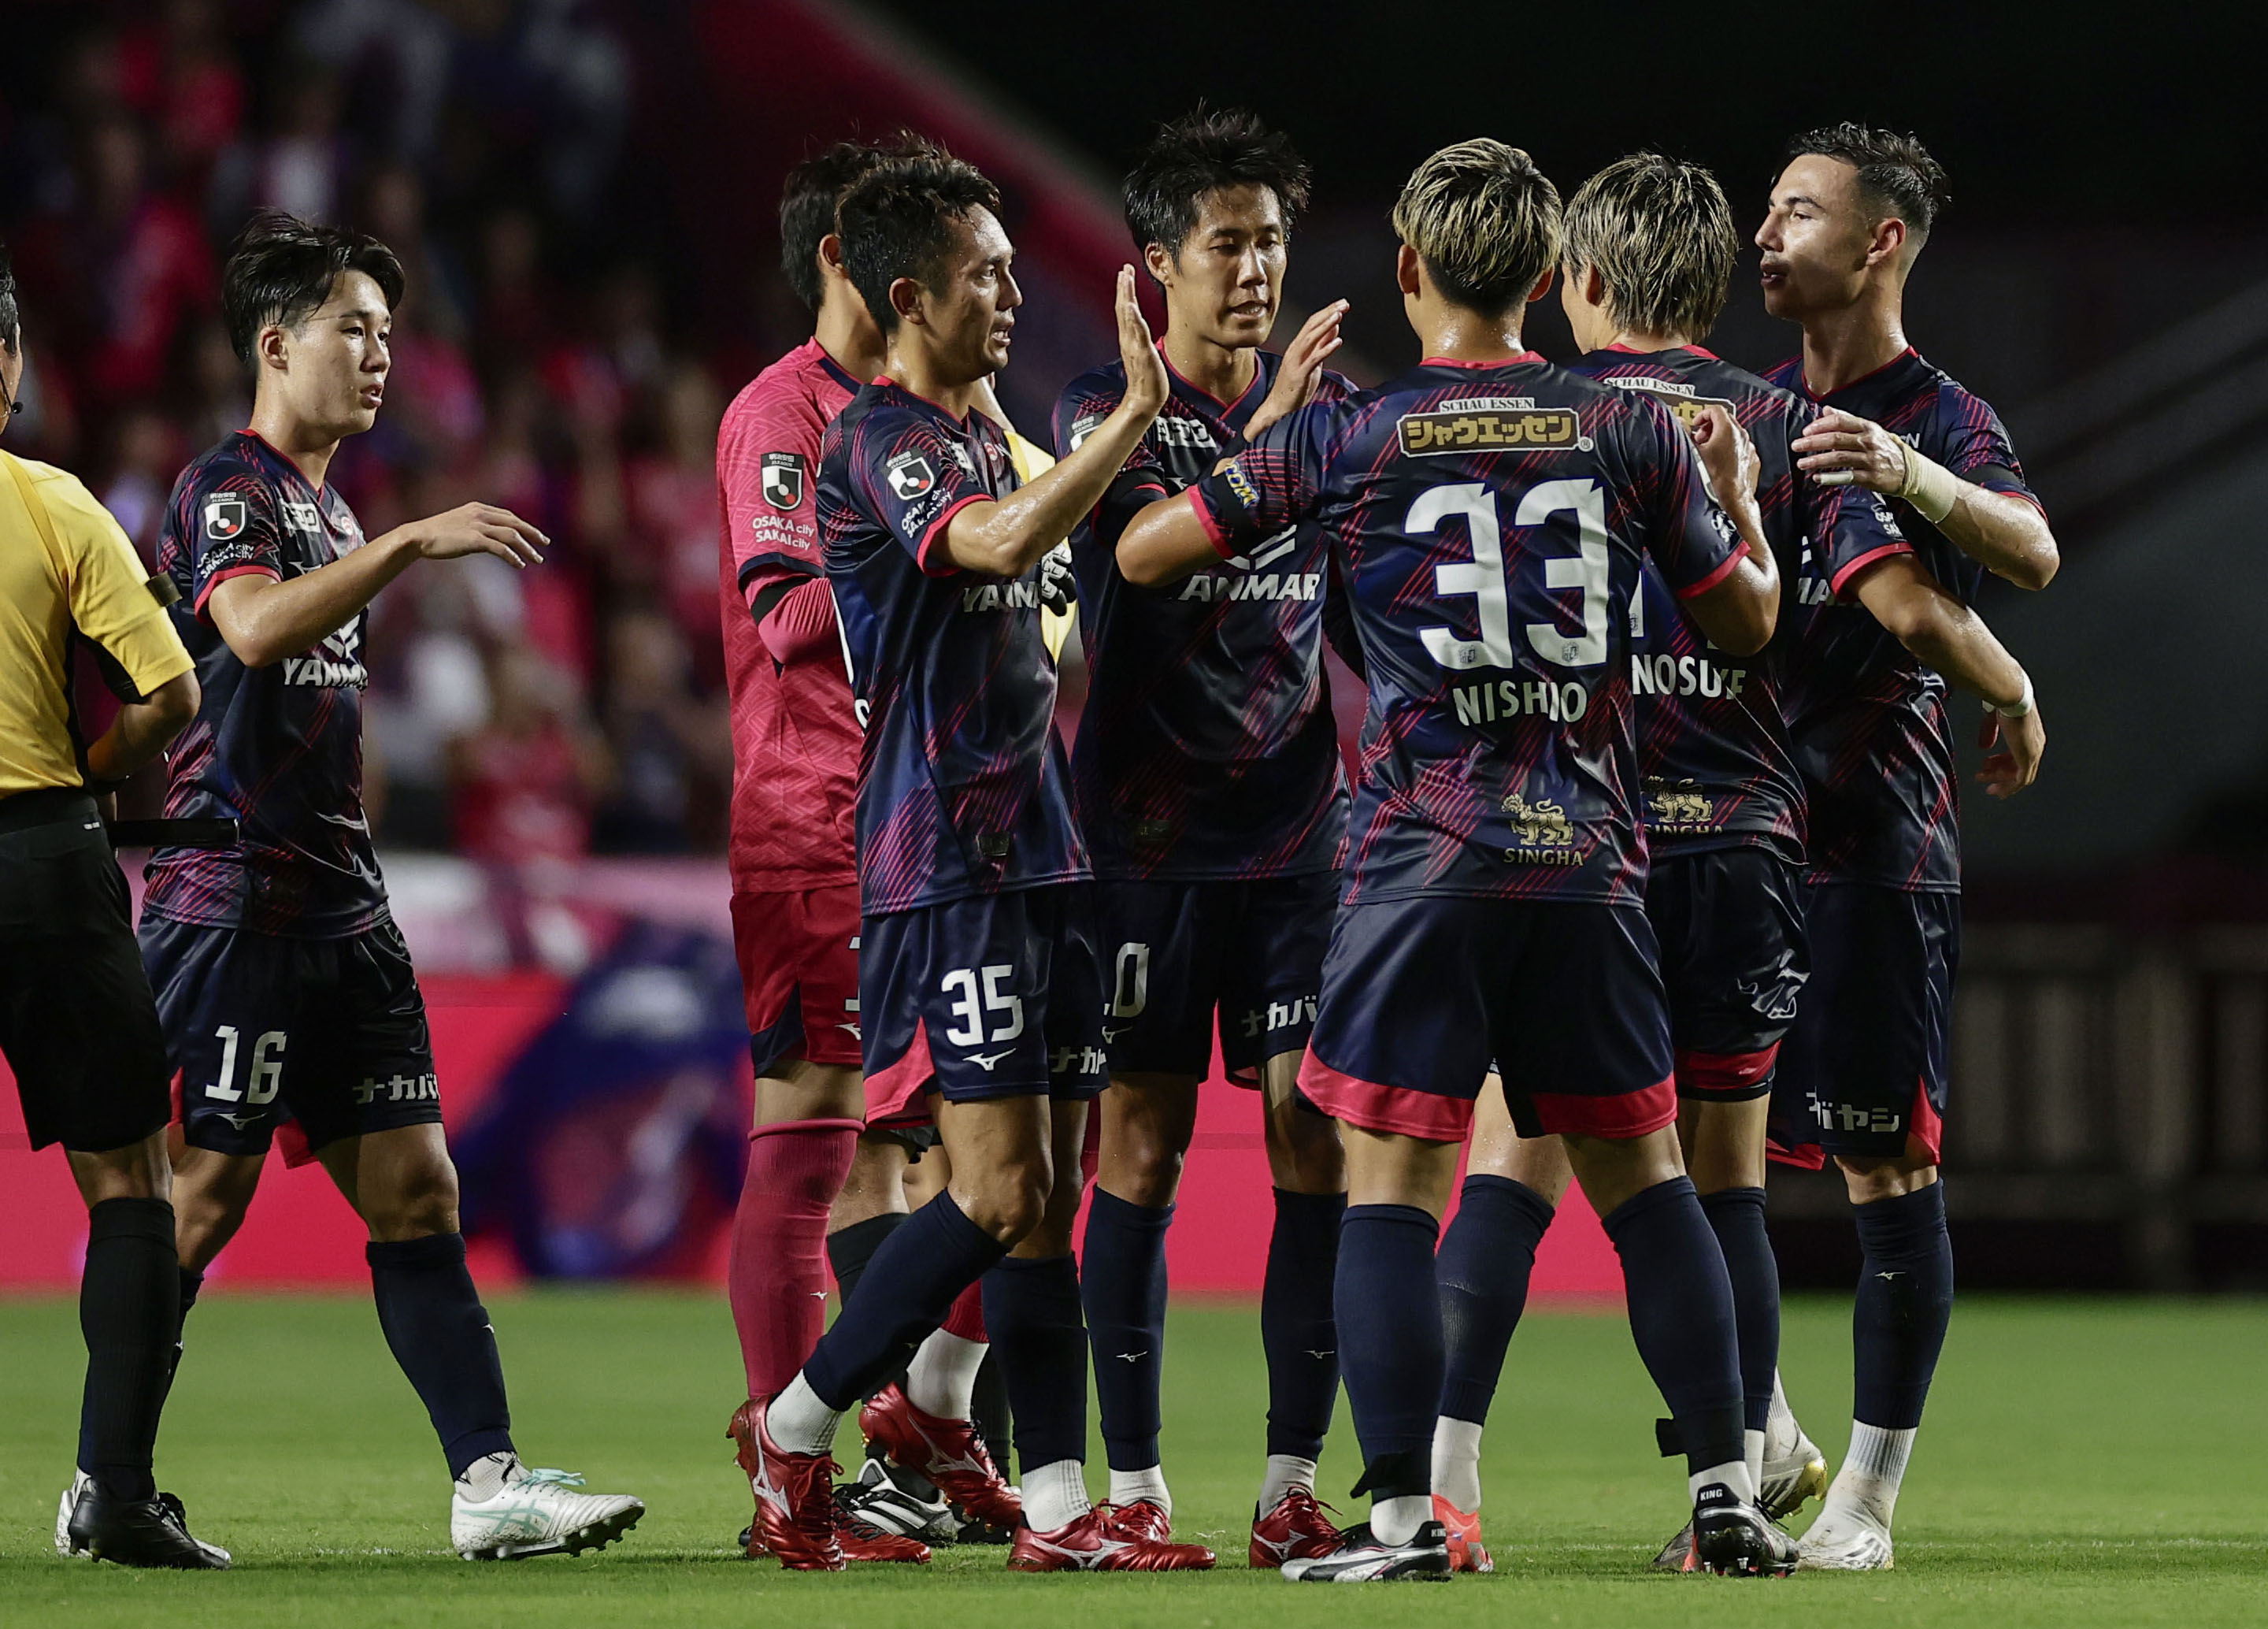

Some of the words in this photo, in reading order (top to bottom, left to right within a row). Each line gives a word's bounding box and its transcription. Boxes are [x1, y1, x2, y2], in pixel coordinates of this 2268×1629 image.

[1654, 382, 1694, 395] ESSEN
[1442, 400, 1486, 412] SCHAU
[1491, 399, 1533, 410] ESSEN
[1406, 415, 1572, 449] シャウエッセン
[752, 516, 795, 532] OSAKA
[795, 525, 814, 537] city
[755, 529, 791, 546] SAKAI
[791, 539, 810, 551] city
[1177, 573, 1321, 603] ANMAR
[1404, 478, 1609, 670] 33
[1453, 680, 1588, 726] NISHIO
[1503, 848, 1584, 866] SINGHA
[941, 964, 1023, 1047] 35
[205, 1025, 287, 1104] 16
[352, 1073, 441, 1104] ナカバ
[1700, 1488, 1723, 1501] KING
